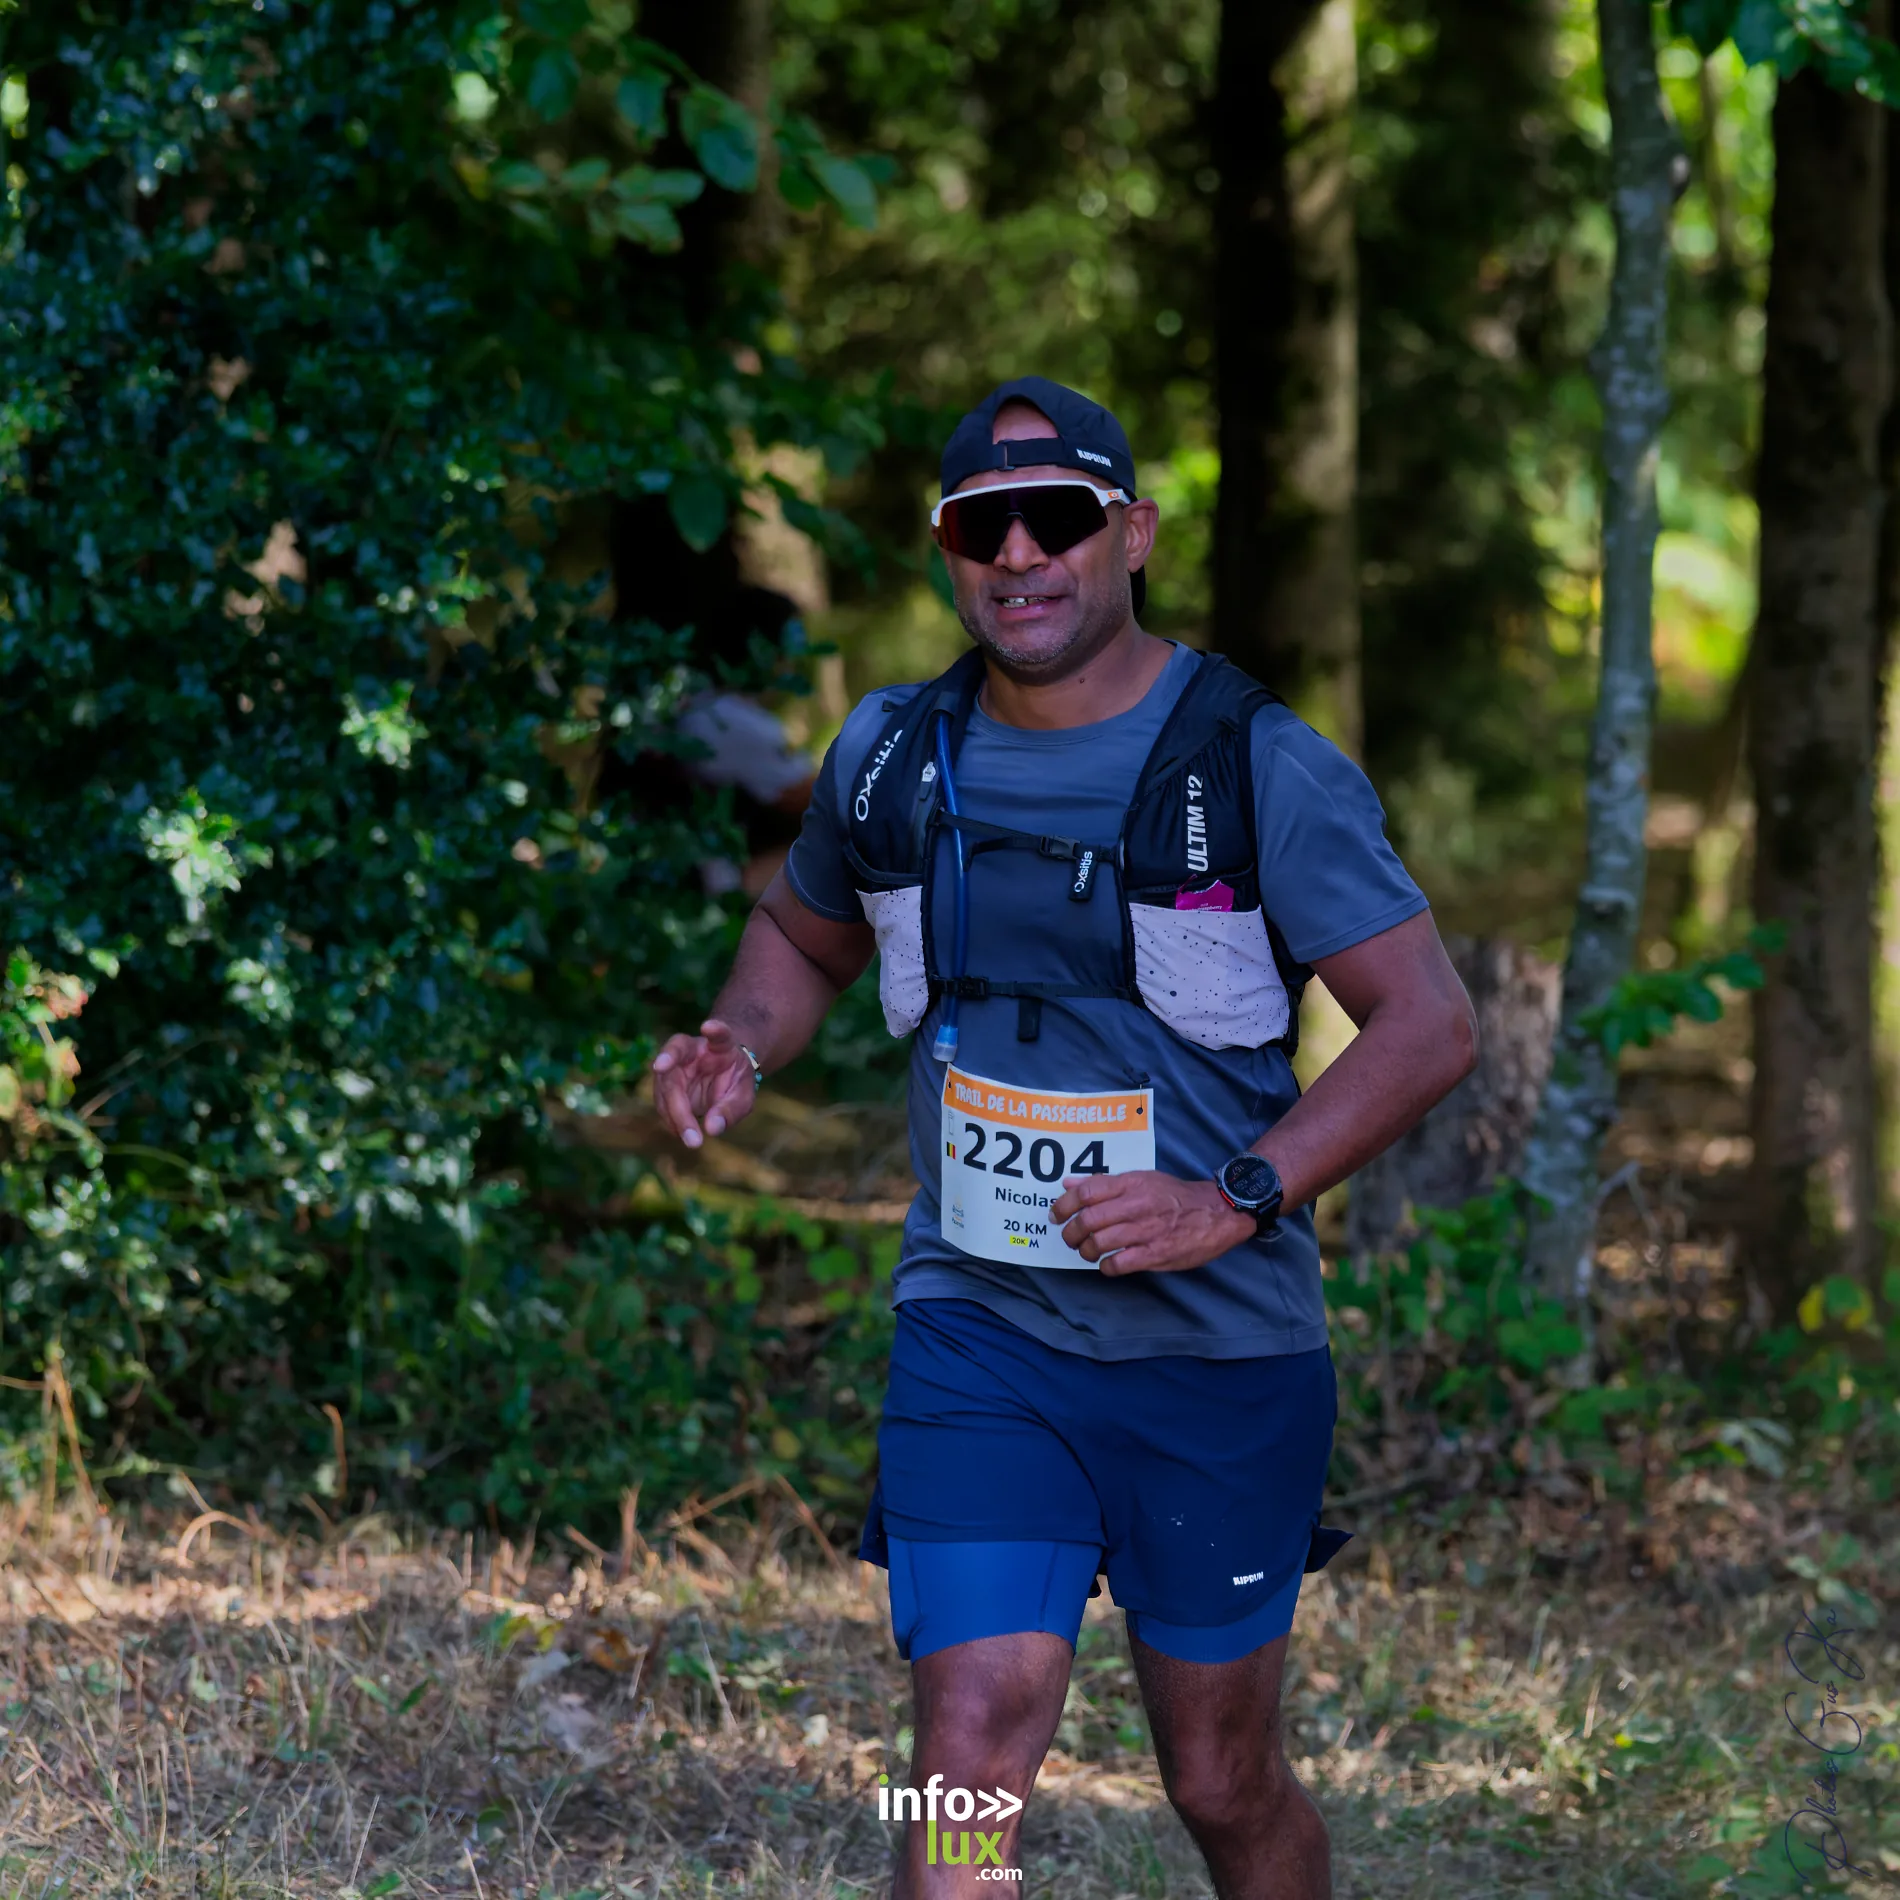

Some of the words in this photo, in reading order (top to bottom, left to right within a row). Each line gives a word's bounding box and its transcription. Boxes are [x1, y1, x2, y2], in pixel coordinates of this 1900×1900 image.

[1076, 448, 1112, 468] KIPRUN
[1187, 774, 1203, 800] 12
[1187, 805, 1209, 872] ULTIM
[1074, 851, 1093, 893] Oxsitis
[954, 1083, 985, 1108] TRAIL
[987, 1093, 1005, 1113] DE
[1008, 1098, 1028, 1119] LA
[1031, 1103, 1127, 1124] PASSERELLE
[963, 1122, 1110, 1183] 2204
[1003, 1219, 1020, 1232] 20
[1025, 1222, 1047, 1235] KM
[1012, 1237, 1026, 1245] 20K
[1029, 1239, 1040, 1249] M
[1232, 1571, 1264, 1586] KIPRUN
